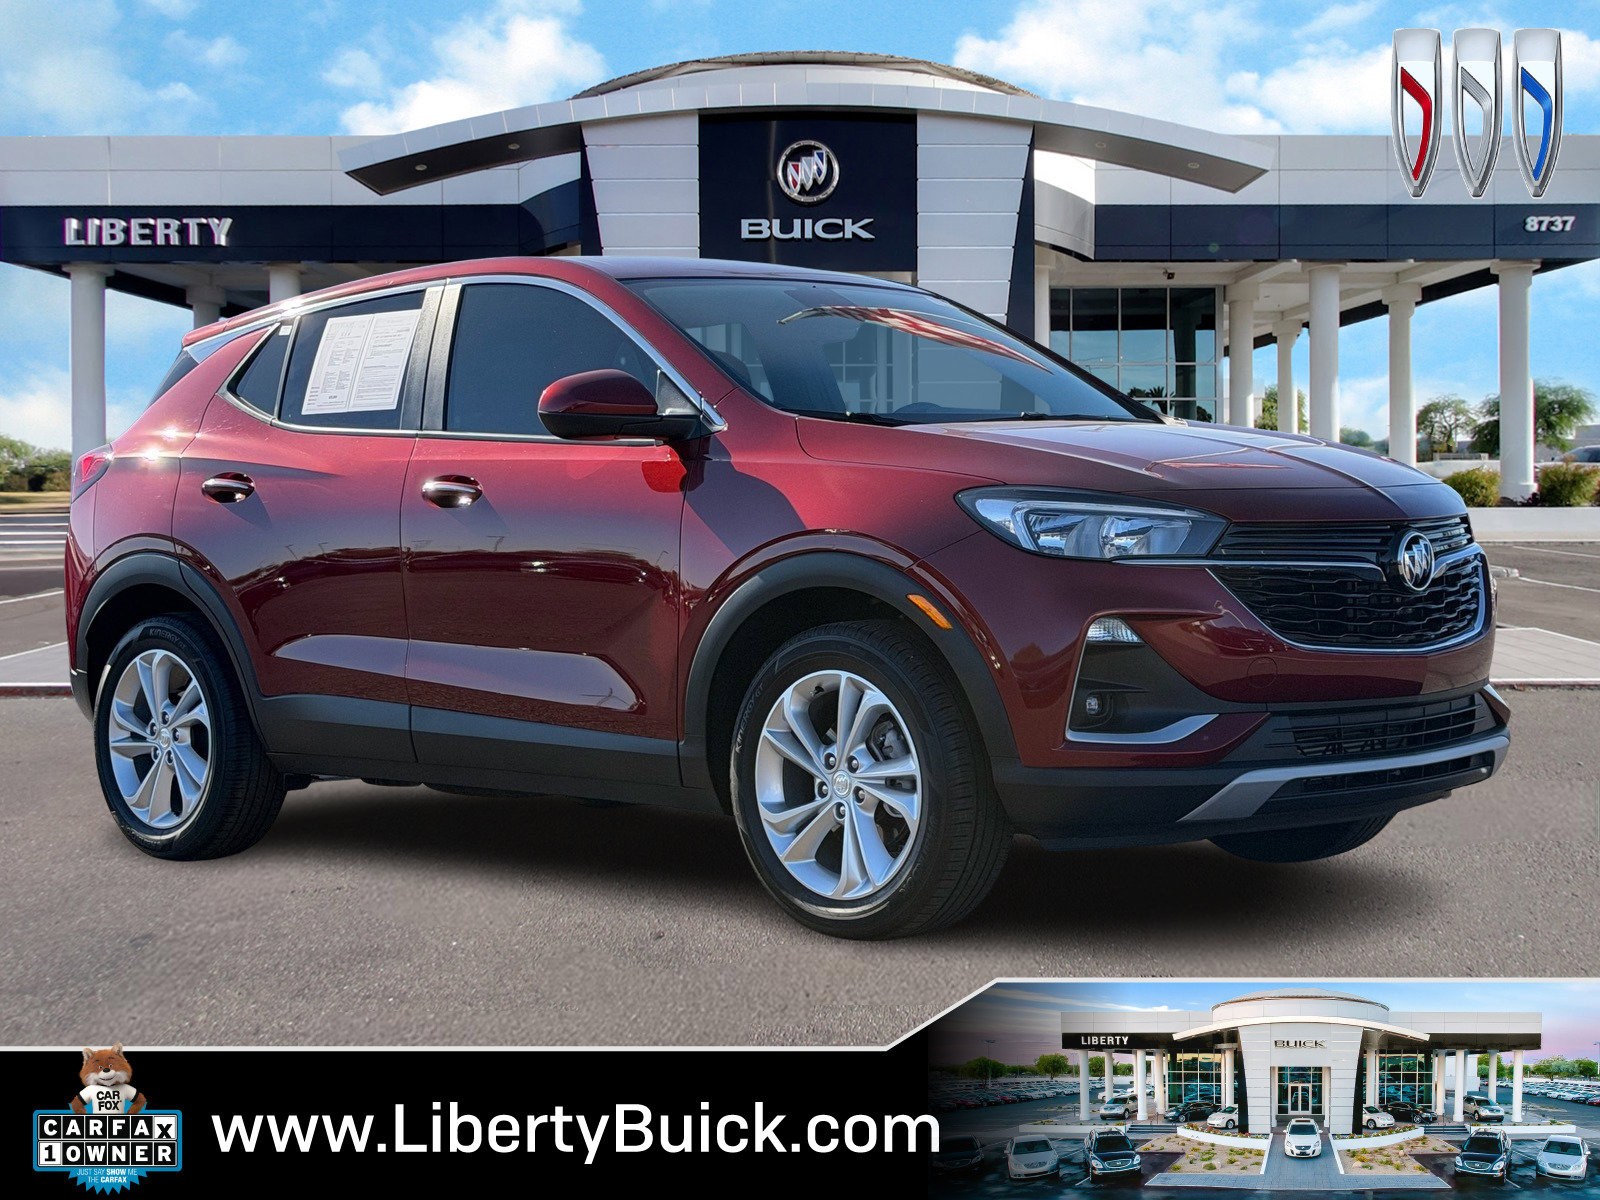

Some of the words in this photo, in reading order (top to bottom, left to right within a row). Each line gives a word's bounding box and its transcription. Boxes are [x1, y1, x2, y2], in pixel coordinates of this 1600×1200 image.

[64, 217, 233, 246] LIBERTY
[740, 218, 876, 239] BUICK
[1525, 215, 1576, 232] 8737
[1081, 1036, 1129, 1045] LIBERTY
[1273, 1039, 1328, 1049] BUICK
